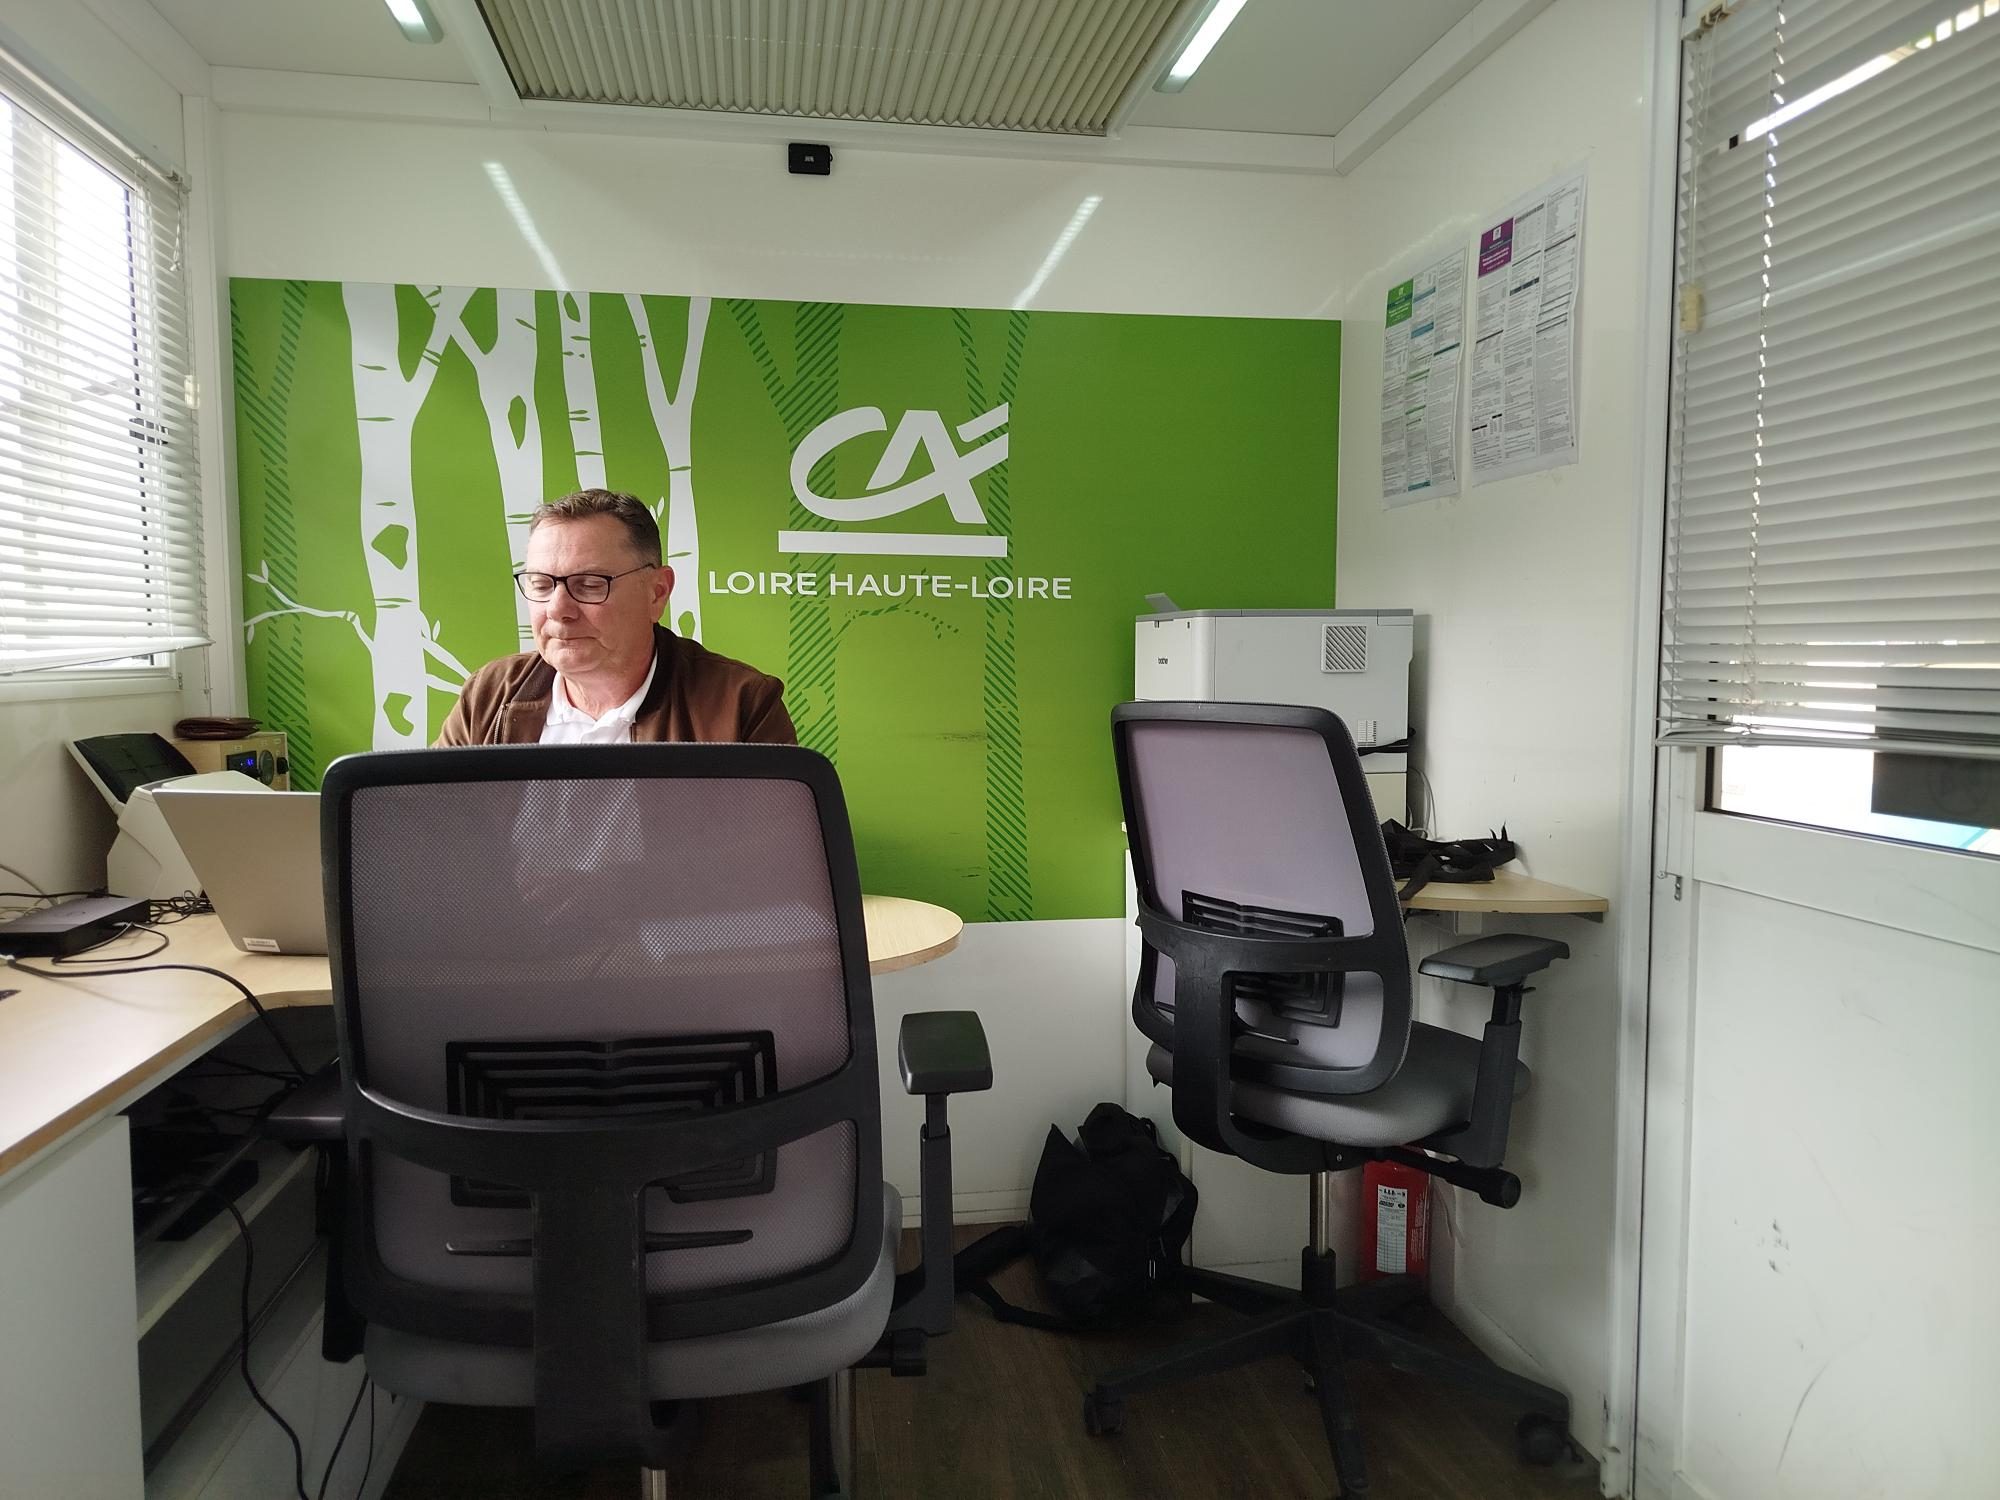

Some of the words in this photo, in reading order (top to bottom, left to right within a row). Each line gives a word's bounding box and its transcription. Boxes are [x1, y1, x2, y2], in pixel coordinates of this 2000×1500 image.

[790, 402, 1009, 524] CA
[709, 570, 818, 596] LOIRE
[830, 573, 1073, 599] HAUTE-LOIRE
